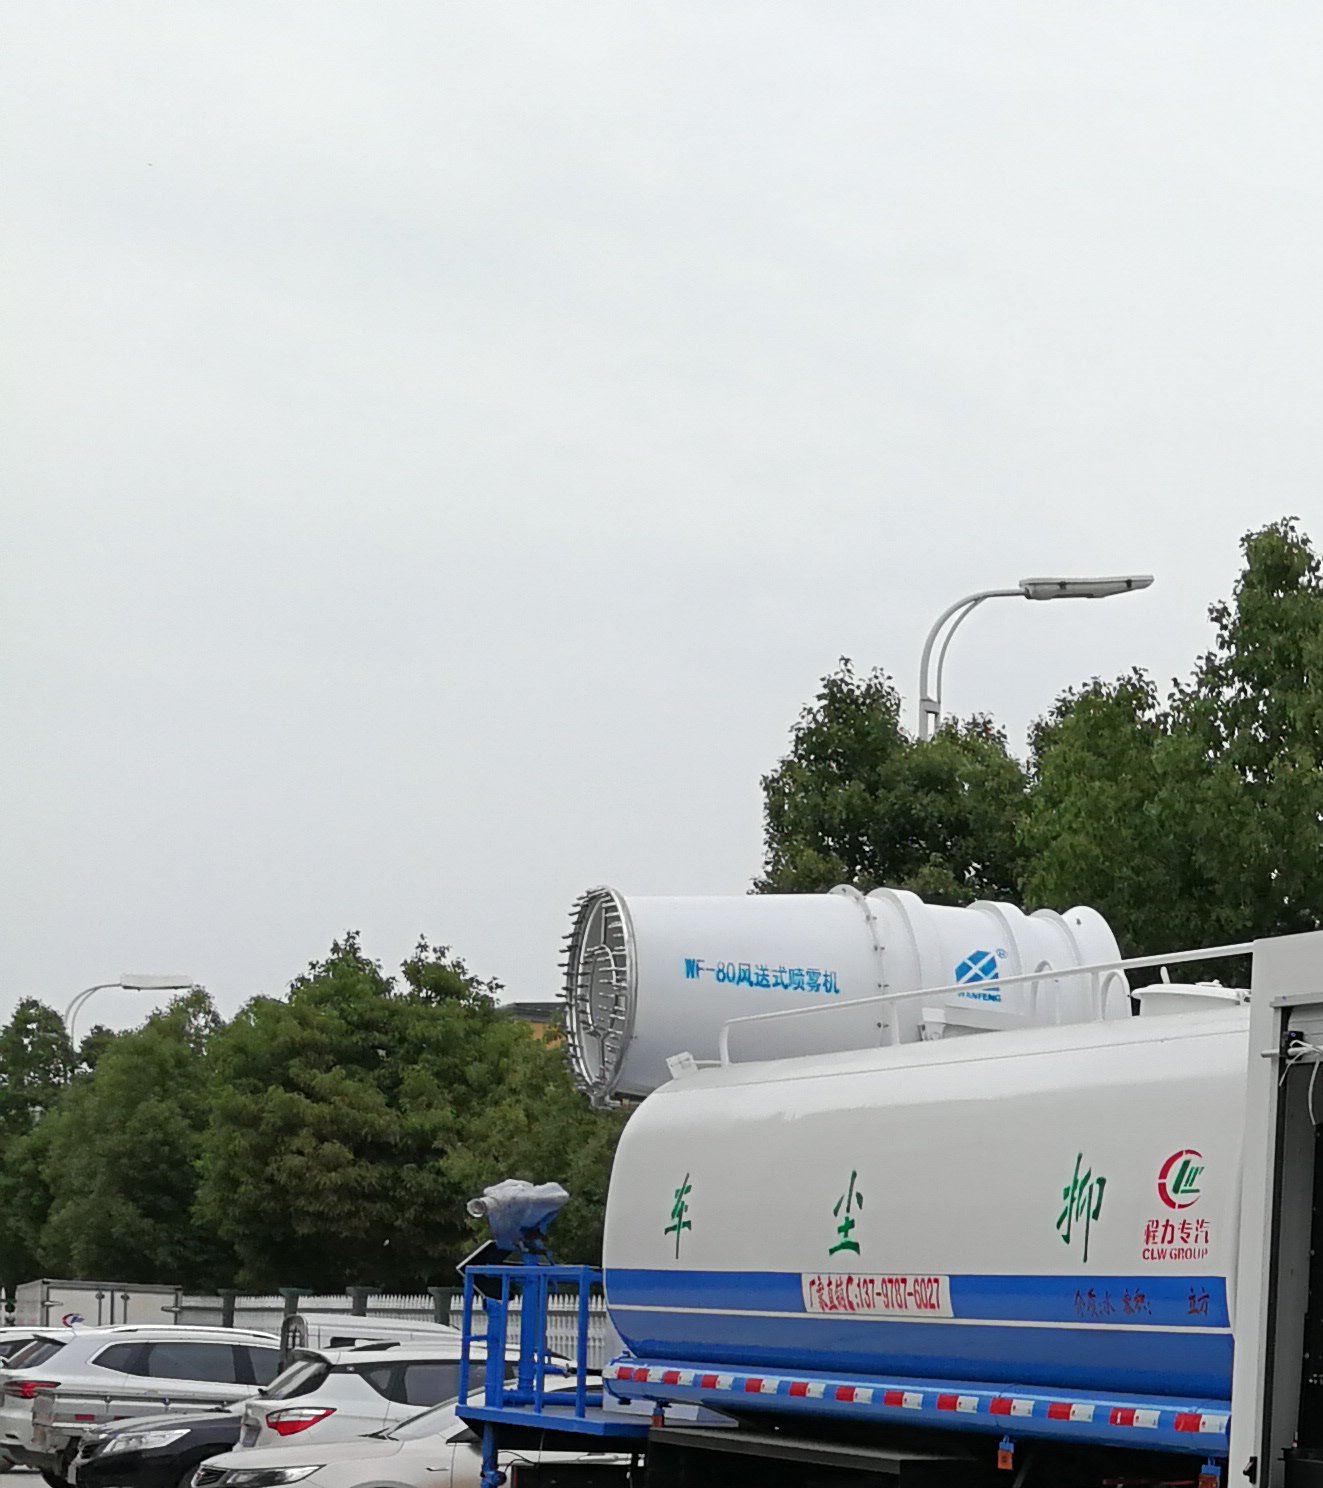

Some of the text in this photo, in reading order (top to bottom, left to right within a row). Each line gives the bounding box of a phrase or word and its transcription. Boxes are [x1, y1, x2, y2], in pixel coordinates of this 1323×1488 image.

[1144, 1218, 1211, 1245] 程力专汽
[1142, 1247, 1208, 1260] CLW GROUP
